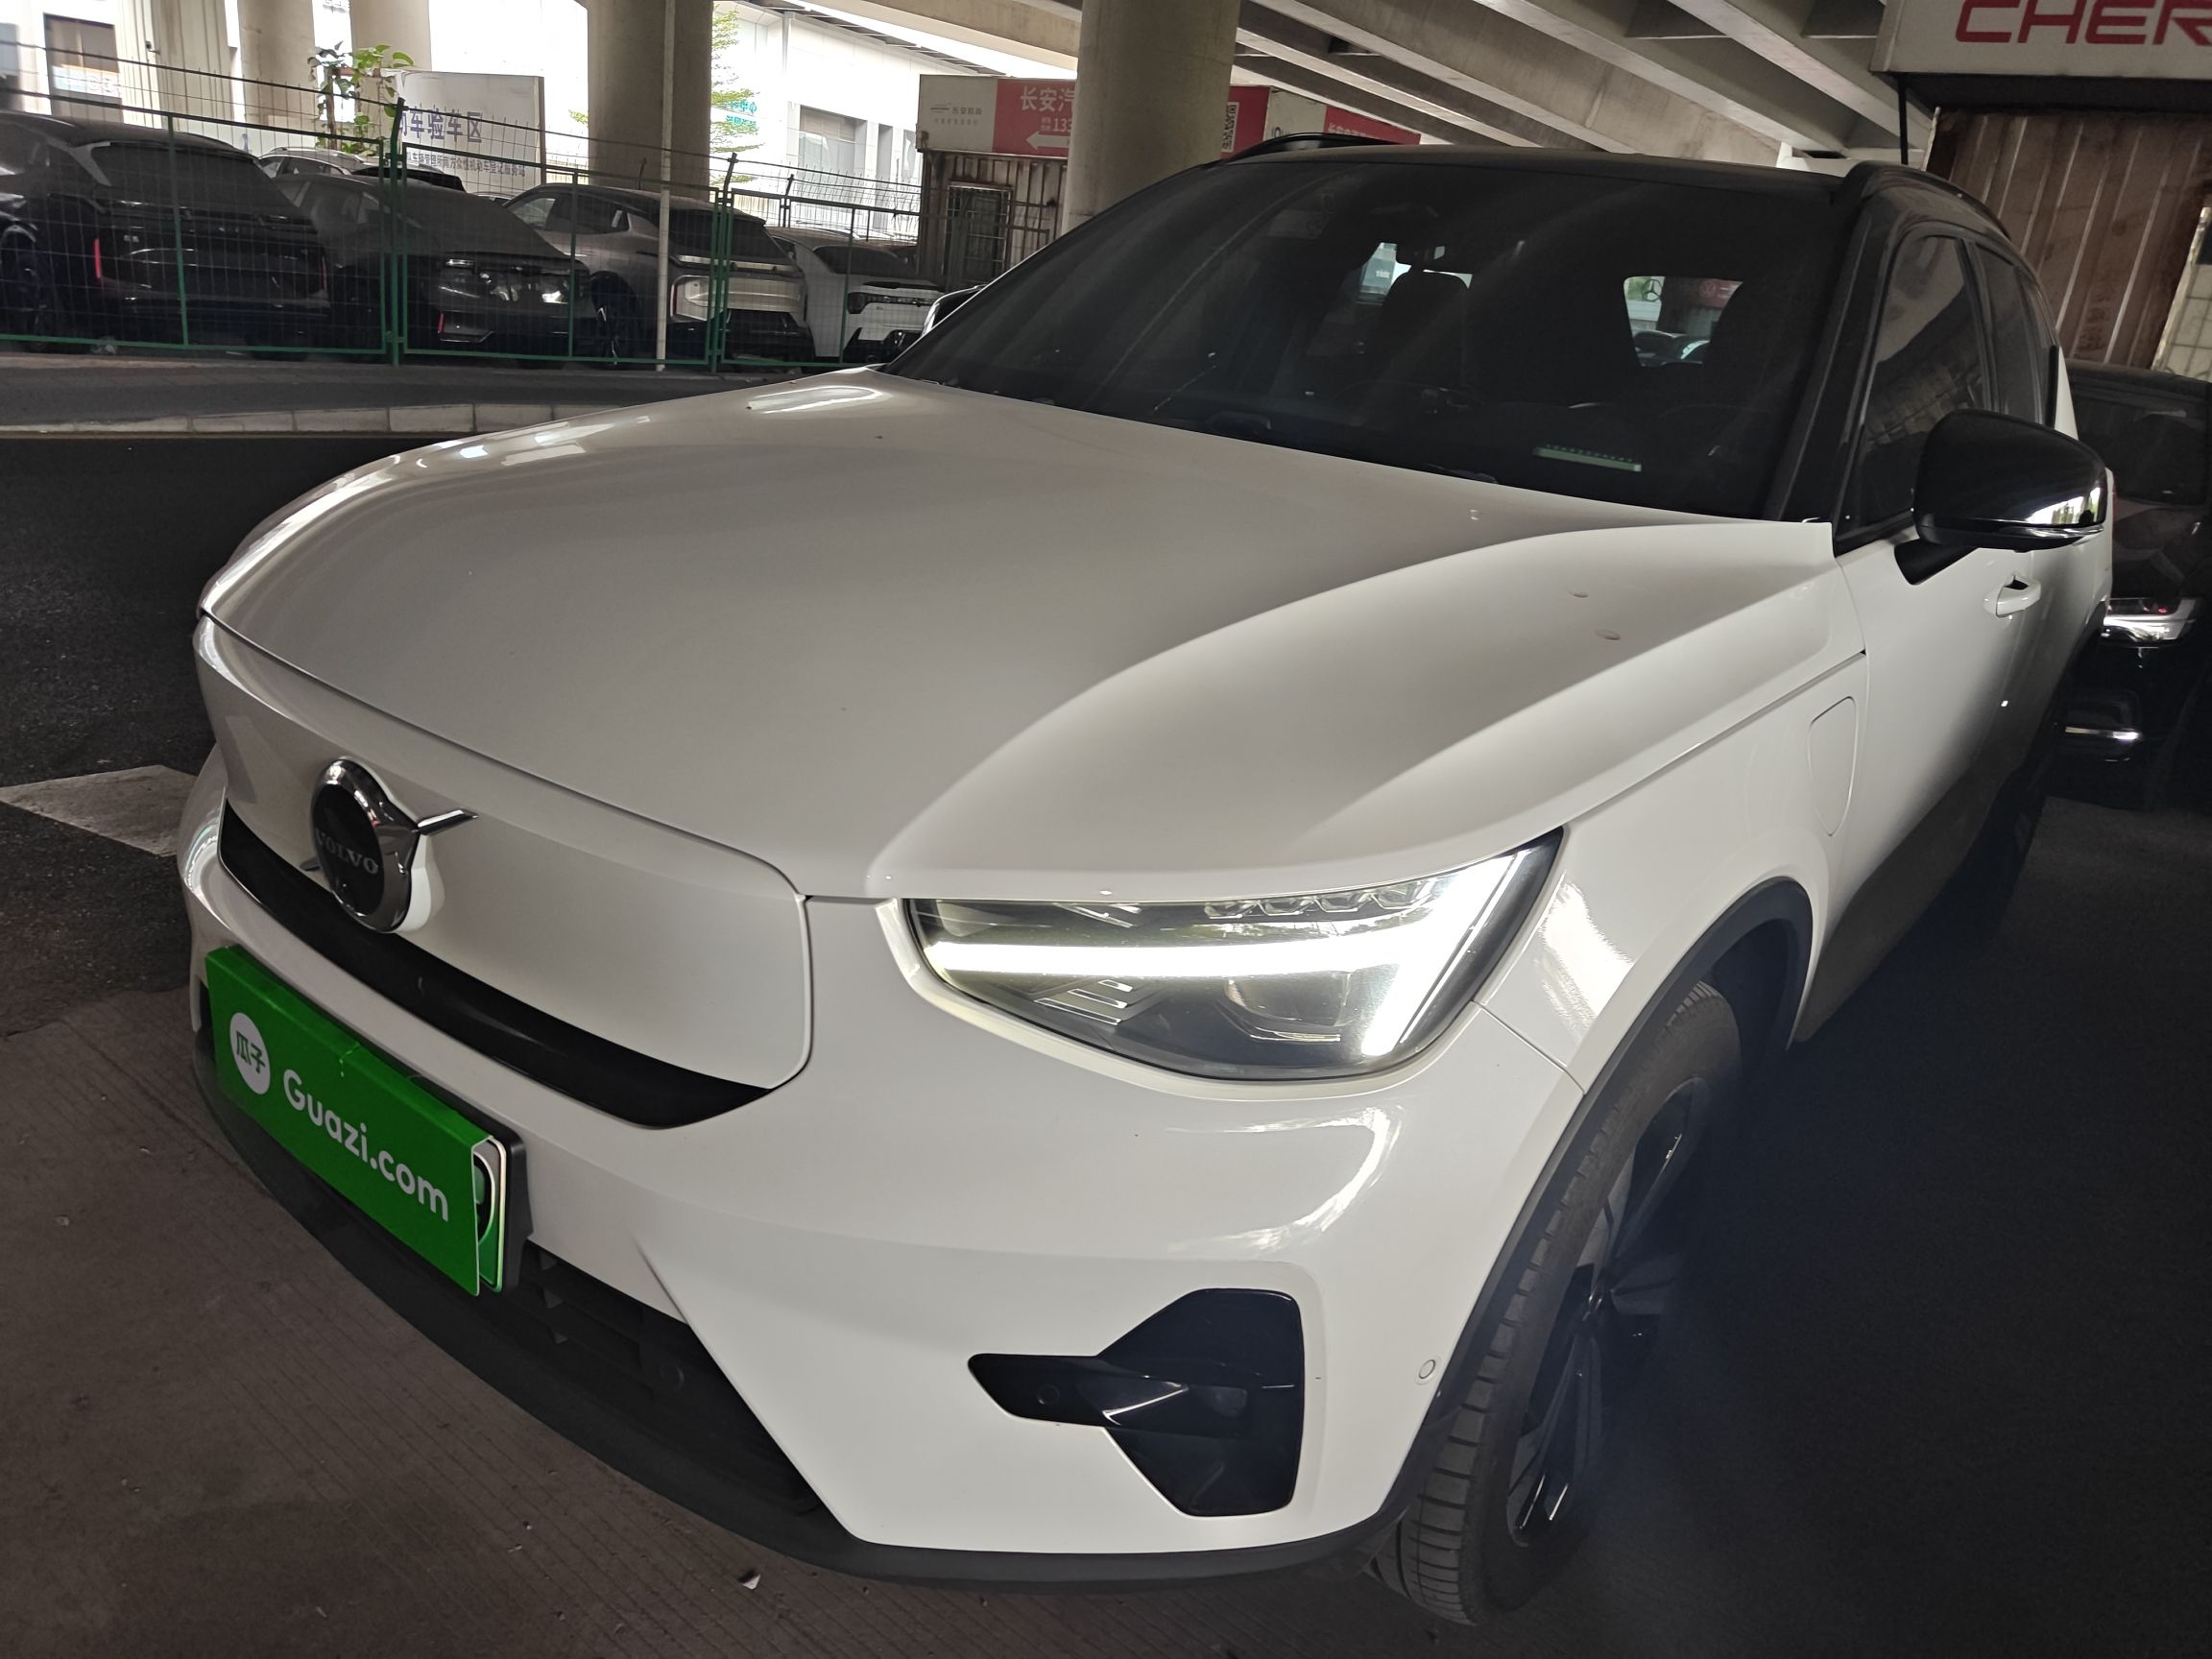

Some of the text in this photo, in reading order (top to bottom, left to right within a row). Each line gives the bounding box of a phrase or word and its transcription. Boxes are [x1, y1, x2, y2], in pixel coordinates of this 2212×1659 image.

[1956, 0, 2212, 46] CHER
[314, 828, 379, 875] VOLVO
[235, 1030, 266, 1074] 瓜子
[283, 1069, 449, 1222] Guazi.com
